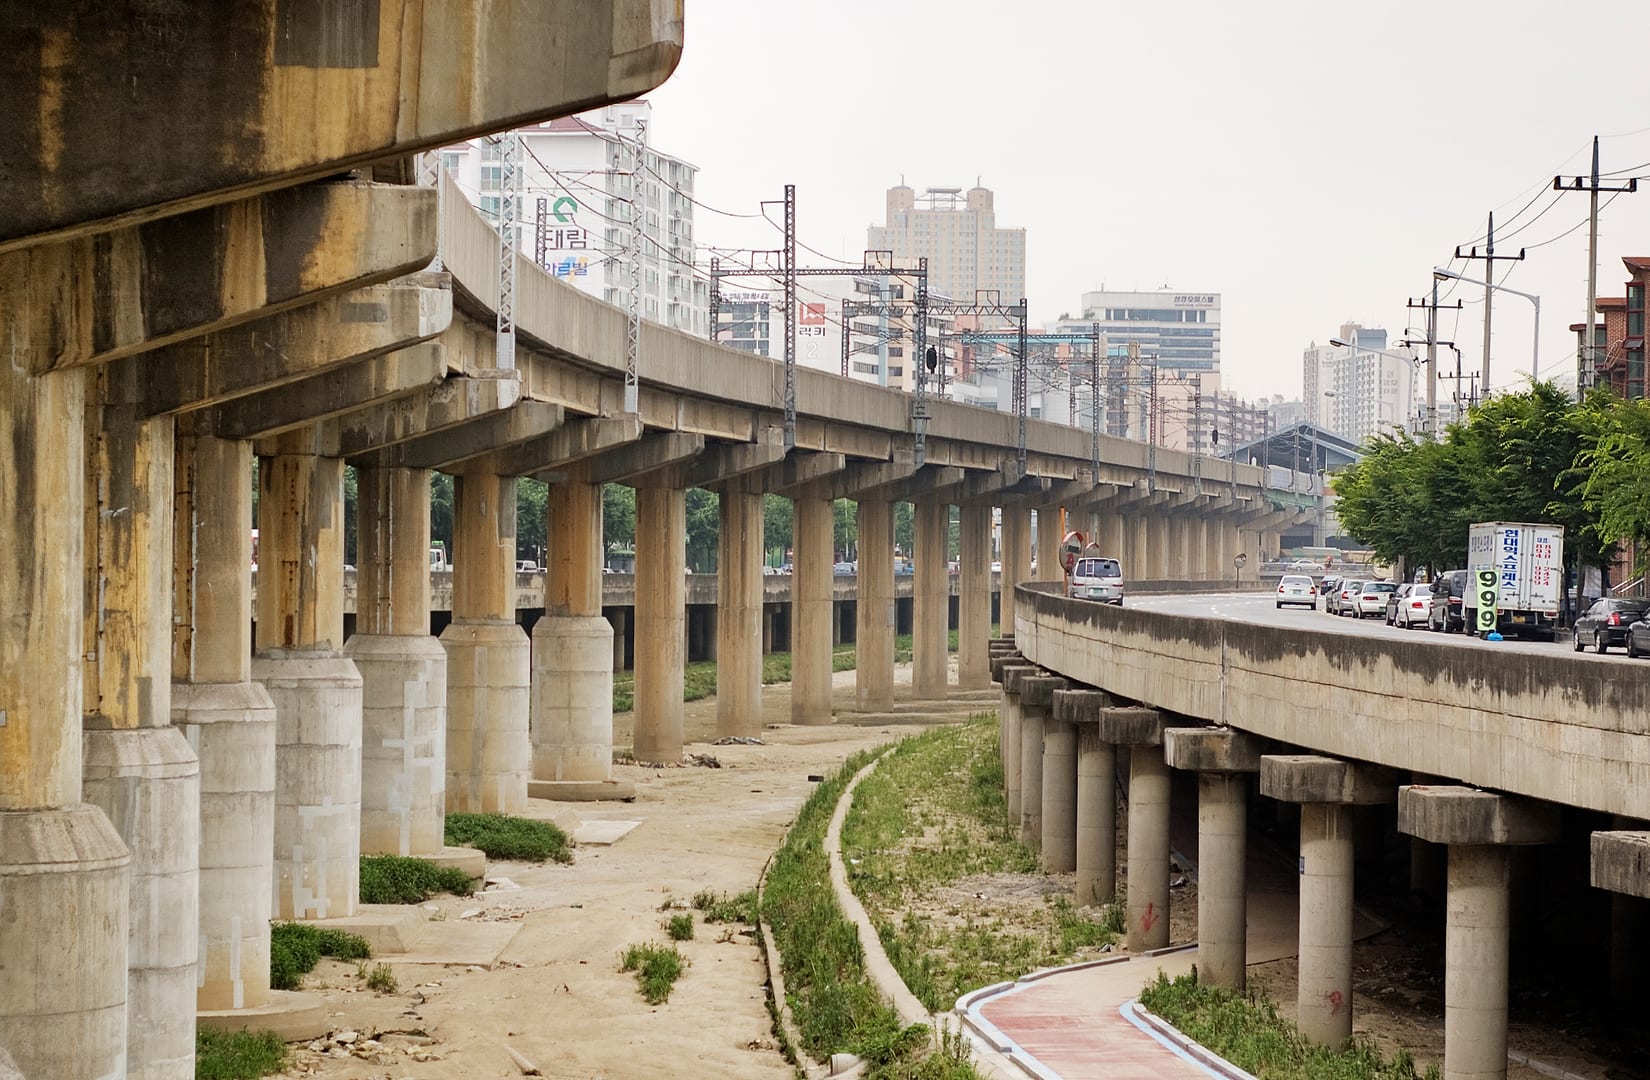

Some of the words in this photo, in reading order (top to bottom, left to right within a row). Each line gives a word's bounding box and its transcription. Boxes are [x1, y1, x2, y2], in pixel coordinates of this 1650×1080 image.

[544, 230, 587, 249] 대림
[799, 327, 826, 336] 럭키
[807, 343, 817, 359] 2
[1501, 529, 1519, 589] 현대익스프레스
